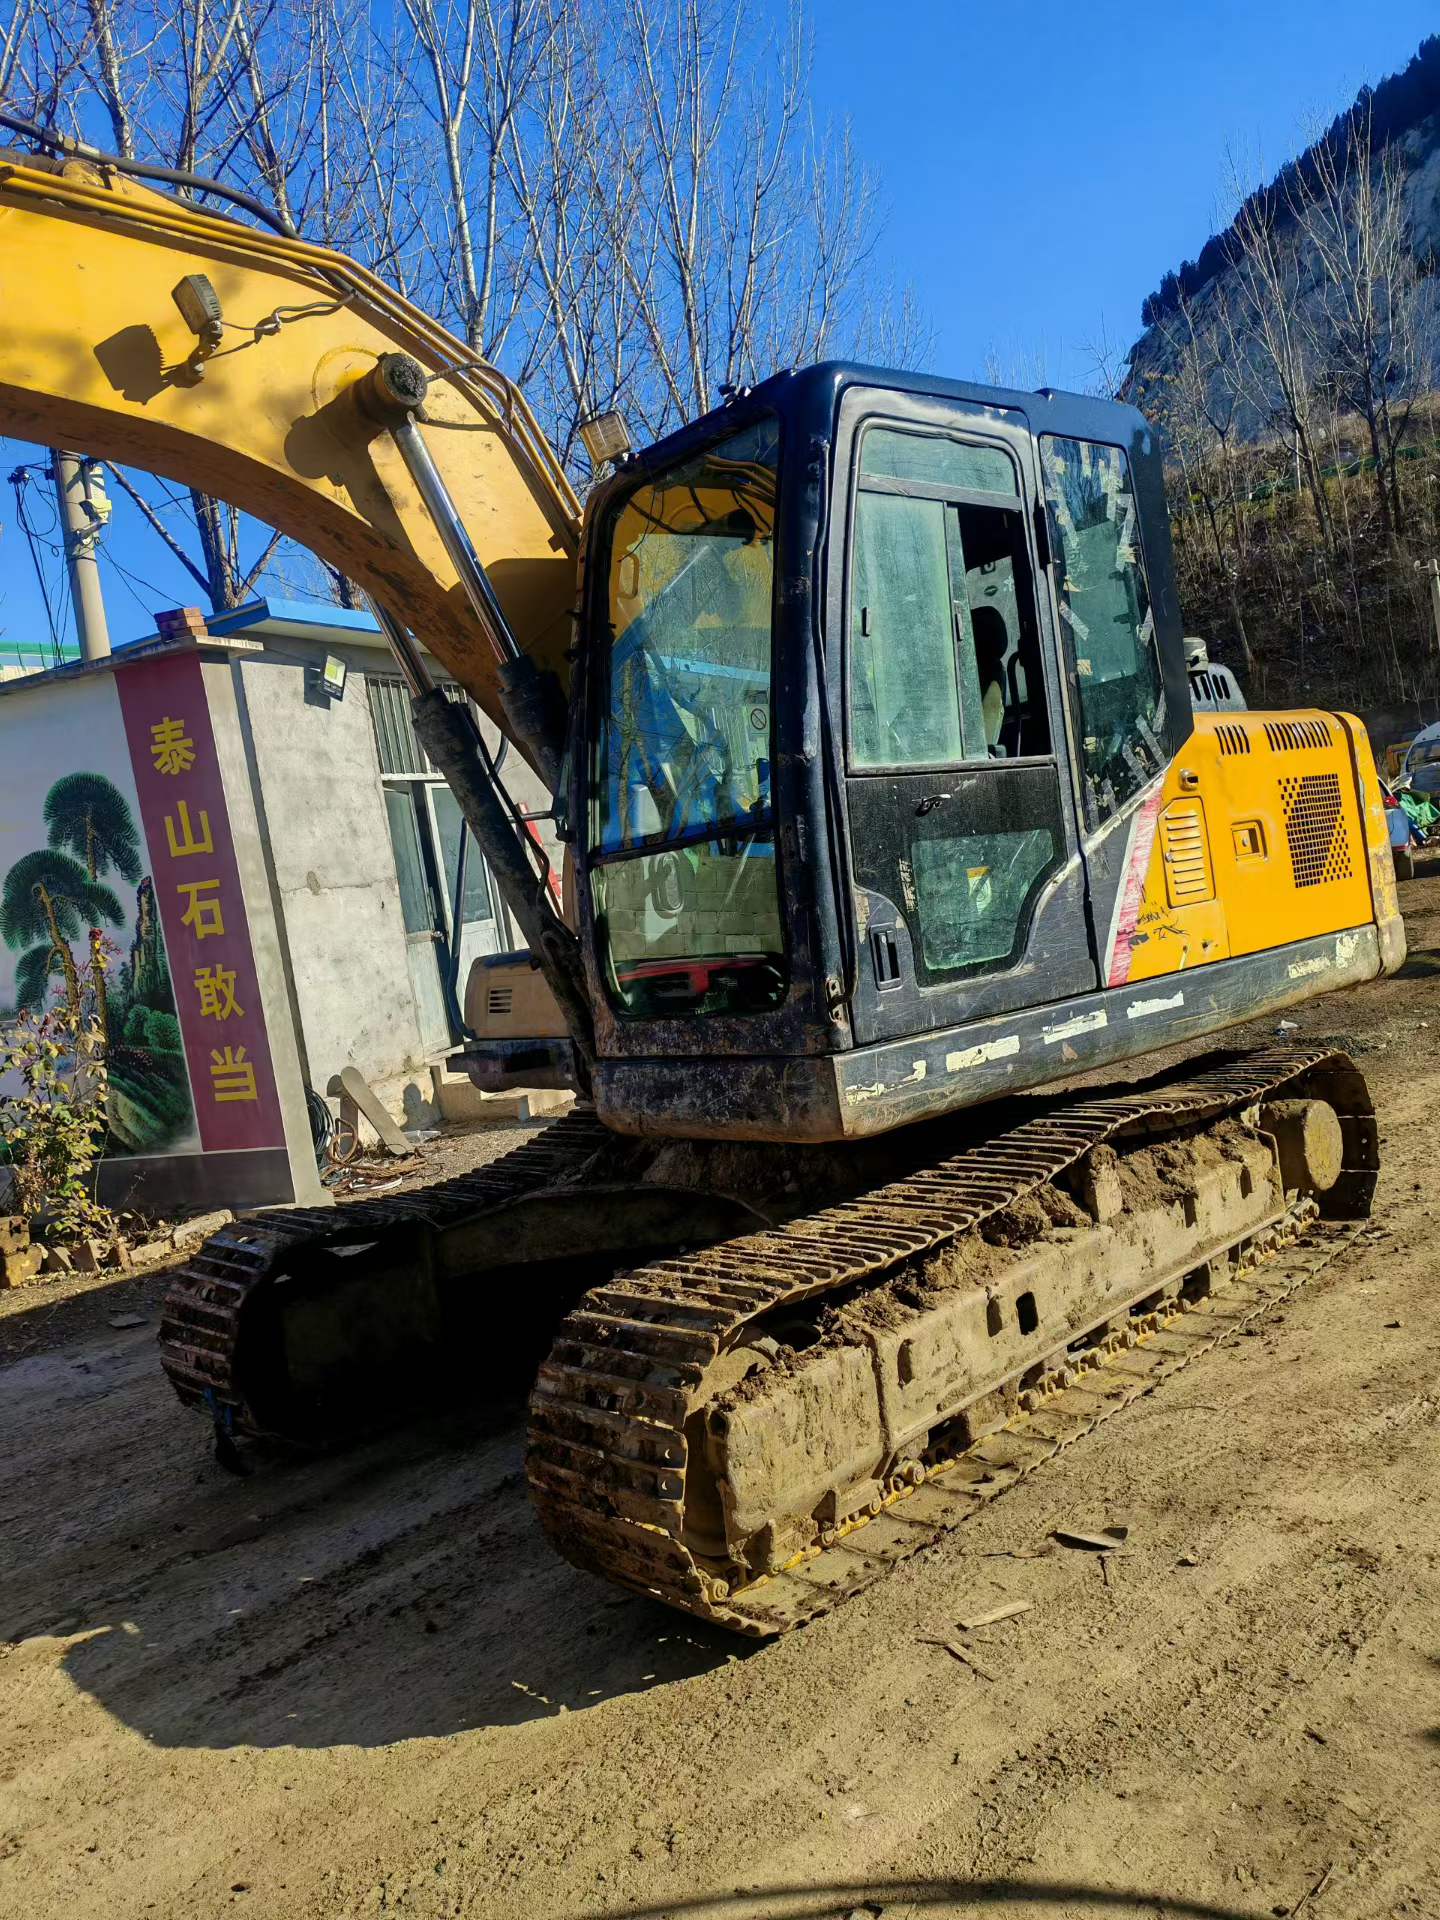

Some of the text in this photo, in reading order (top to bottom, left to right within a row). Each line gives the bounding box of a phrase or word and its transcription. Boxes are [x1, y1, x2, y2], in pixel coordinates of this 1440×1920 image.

[151, 718, 258, 1102] 泰山石敢当
